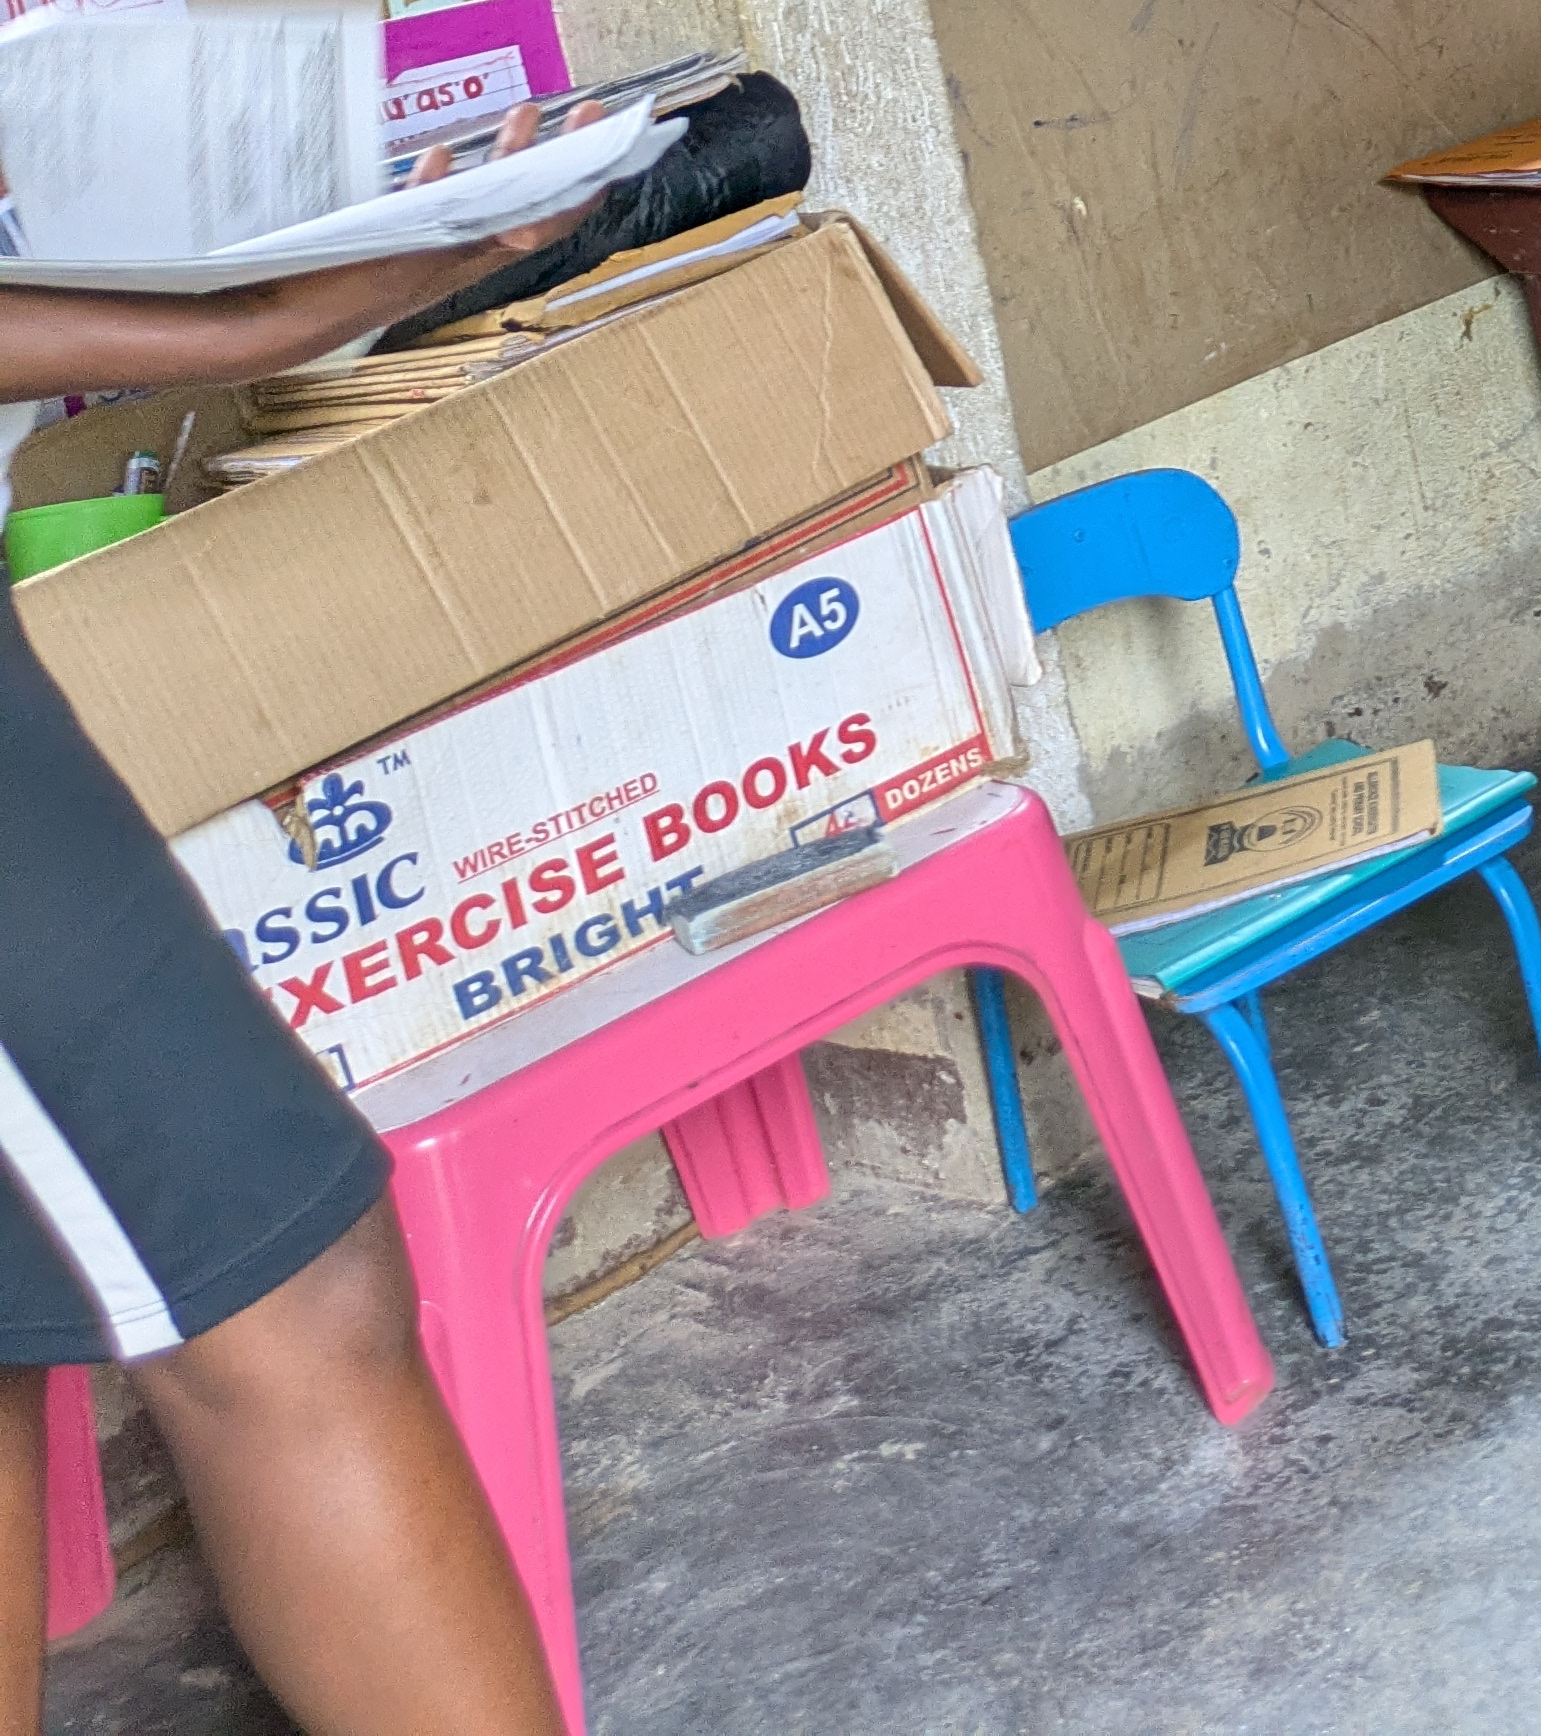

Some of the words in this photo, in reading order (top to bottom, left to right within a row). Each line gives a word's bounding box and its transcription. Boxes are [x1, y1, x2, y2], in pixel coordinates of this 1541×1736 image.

[788, 586, 848, 650] A5
[376, 748, 412, 776] TM
[885, 745, 984, 811] DOZENS
[452, 771, 660, 881] WIRE-STITCHED
[258, 832, 626, 1030] XERCISE
[643, 712, 878, 862] BOOKS
